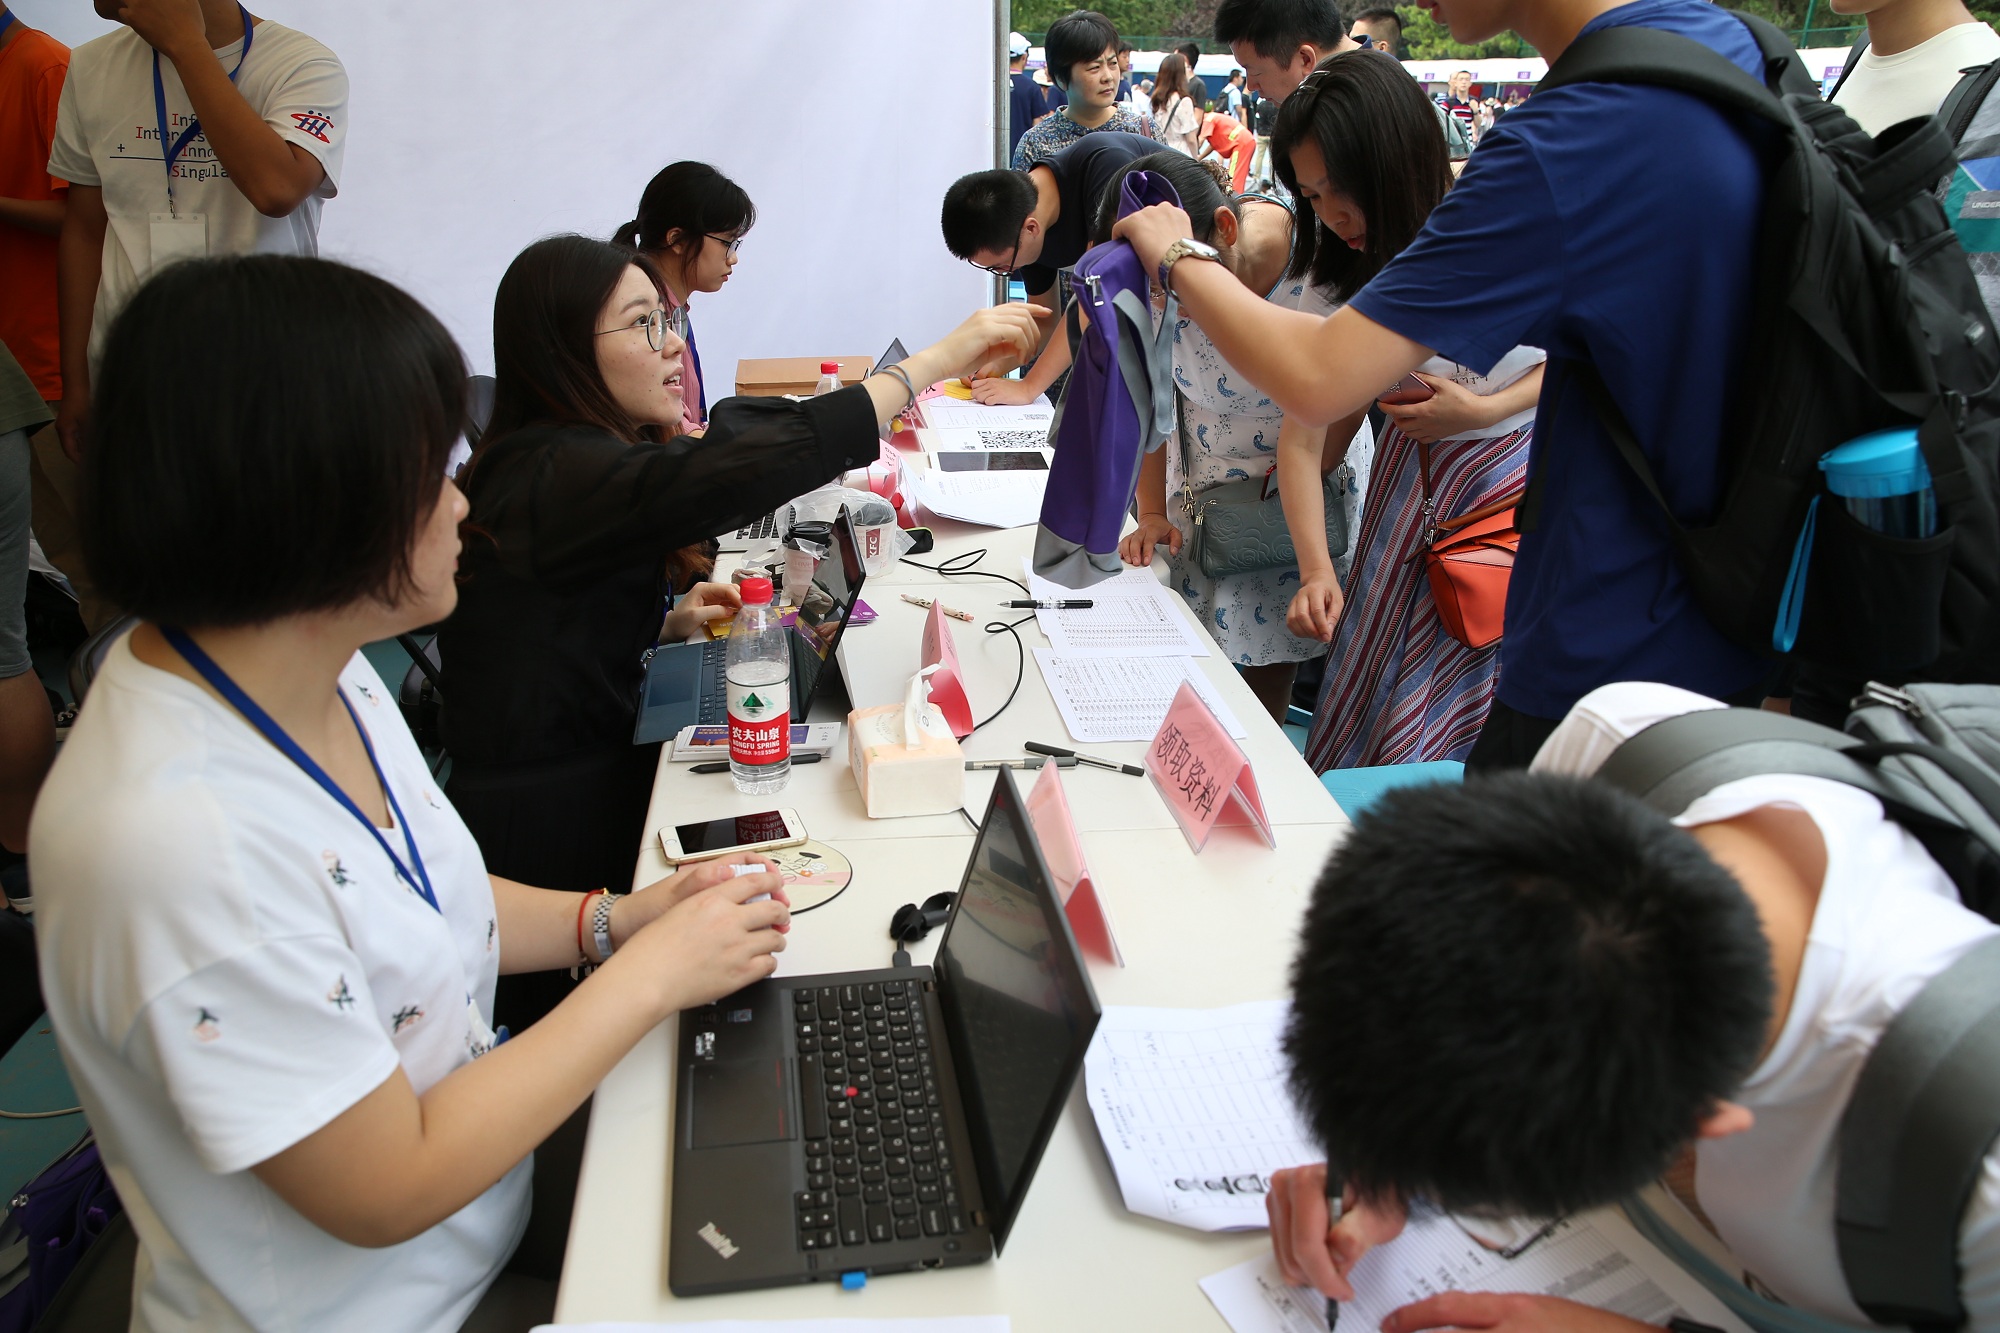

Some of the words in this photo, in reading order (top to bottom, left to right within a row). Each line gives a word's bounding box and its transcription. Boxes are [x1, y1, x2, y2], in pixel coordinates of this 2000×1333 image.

[732, 726, 780, 742] 农夫山泉
[733, 739, 755, 750] NONGFU
[757, 739, 780, 749] SPRING
[1157, 722, 1221, 822] 领取资料
